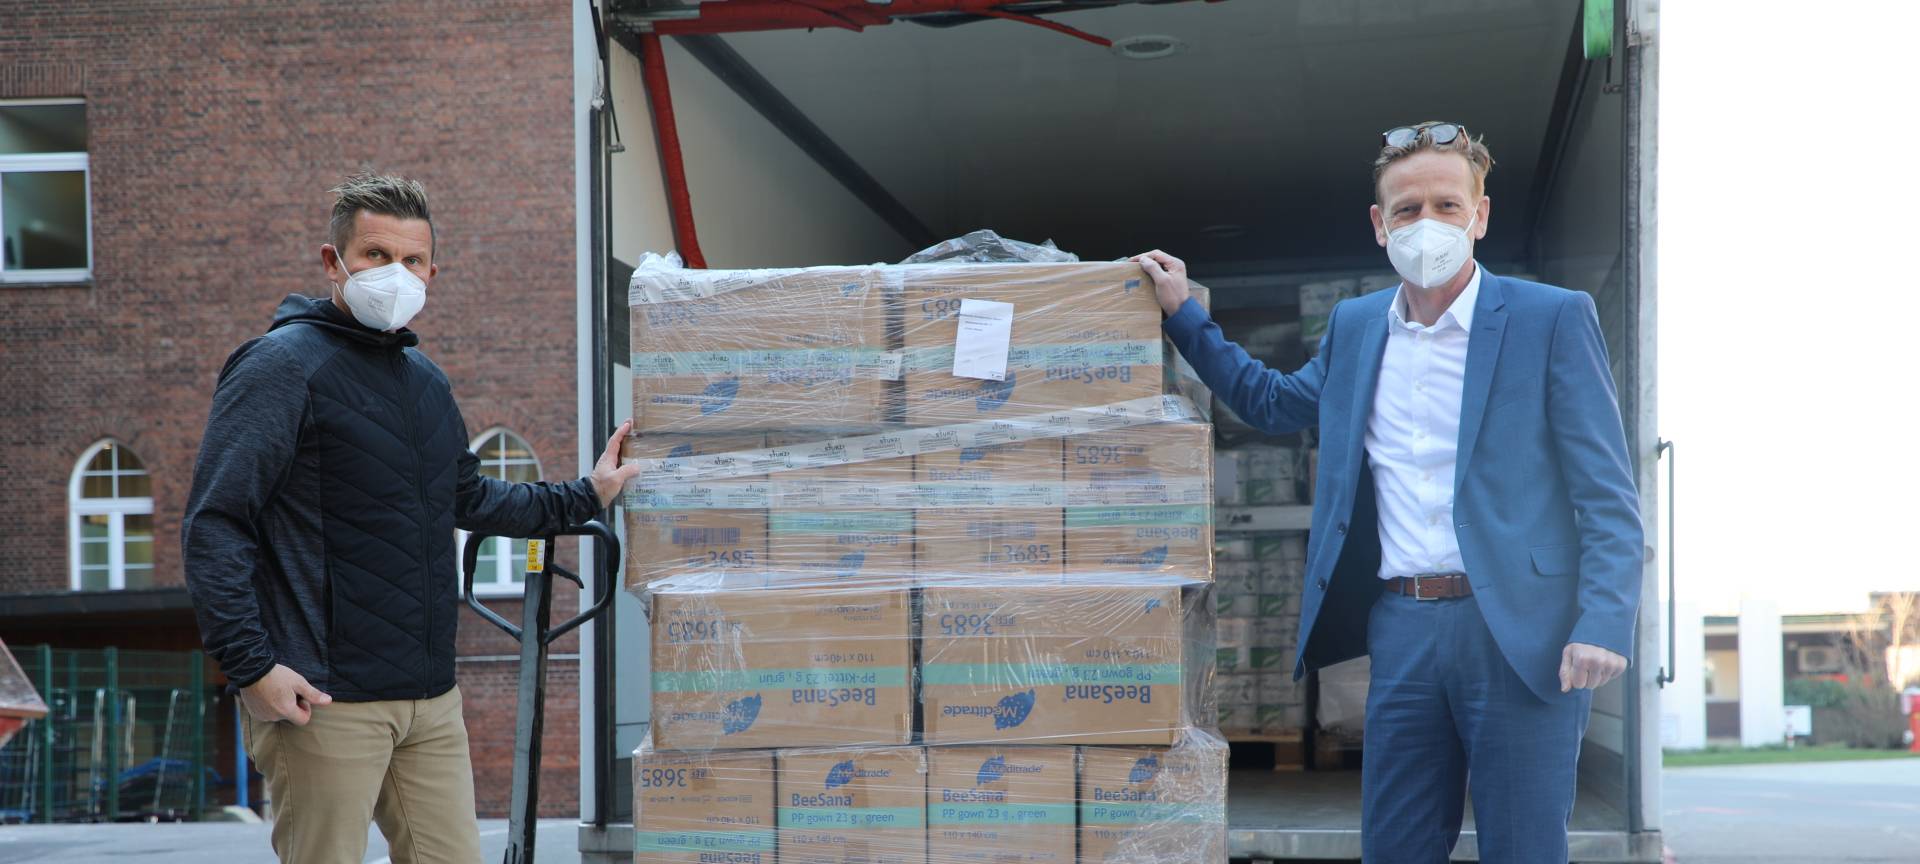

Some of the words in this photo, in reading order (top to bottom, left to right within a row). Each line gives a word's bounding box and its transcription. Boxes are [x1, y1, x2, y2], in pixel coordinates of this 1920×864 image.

[921, 298, 962, 321] 685
[1043, 364, 1132, 384] BeeSana
[1076, 446, 1125, 465] 3685
[1136, 527, 1200, 541] BeeSana
[1002, 545, 1051, 563] 3685
[939, 614, 995, 636] 3685
[857, 653, 875, 662] 110
[759, 671, 785, 684] grün
[1101, 667, 1133, 679] gown
[1136, 671, 1152, 680] PP
[791, 687, 877, 707] BeeSana
[1064, 685, 1152, 705] BeeSana
[943, 705, 1018, 719] Meditrade
[641, 768, 688, 788] 3685
[791, 792, 852, 807] BeeSana
[943, 788, 1005, 802] BeeSana
[745, 815, 761, 825] 110
[791, 812, 805, 824] PP
[807, 814, 833, 826] gown
[865, 813, 895, 825] green
[942, 808, 956, 819] PP
[958, 809, 985, 821] gown
[987, 808, 1000, 819] 23
[1017, 809, 1047, 821] green
[1094, 807, 1108, 818] PP
[1110, 808, 1137, 820] gown
[657, 835, 688, 847] green
[703, 837, 716, 847] 23
